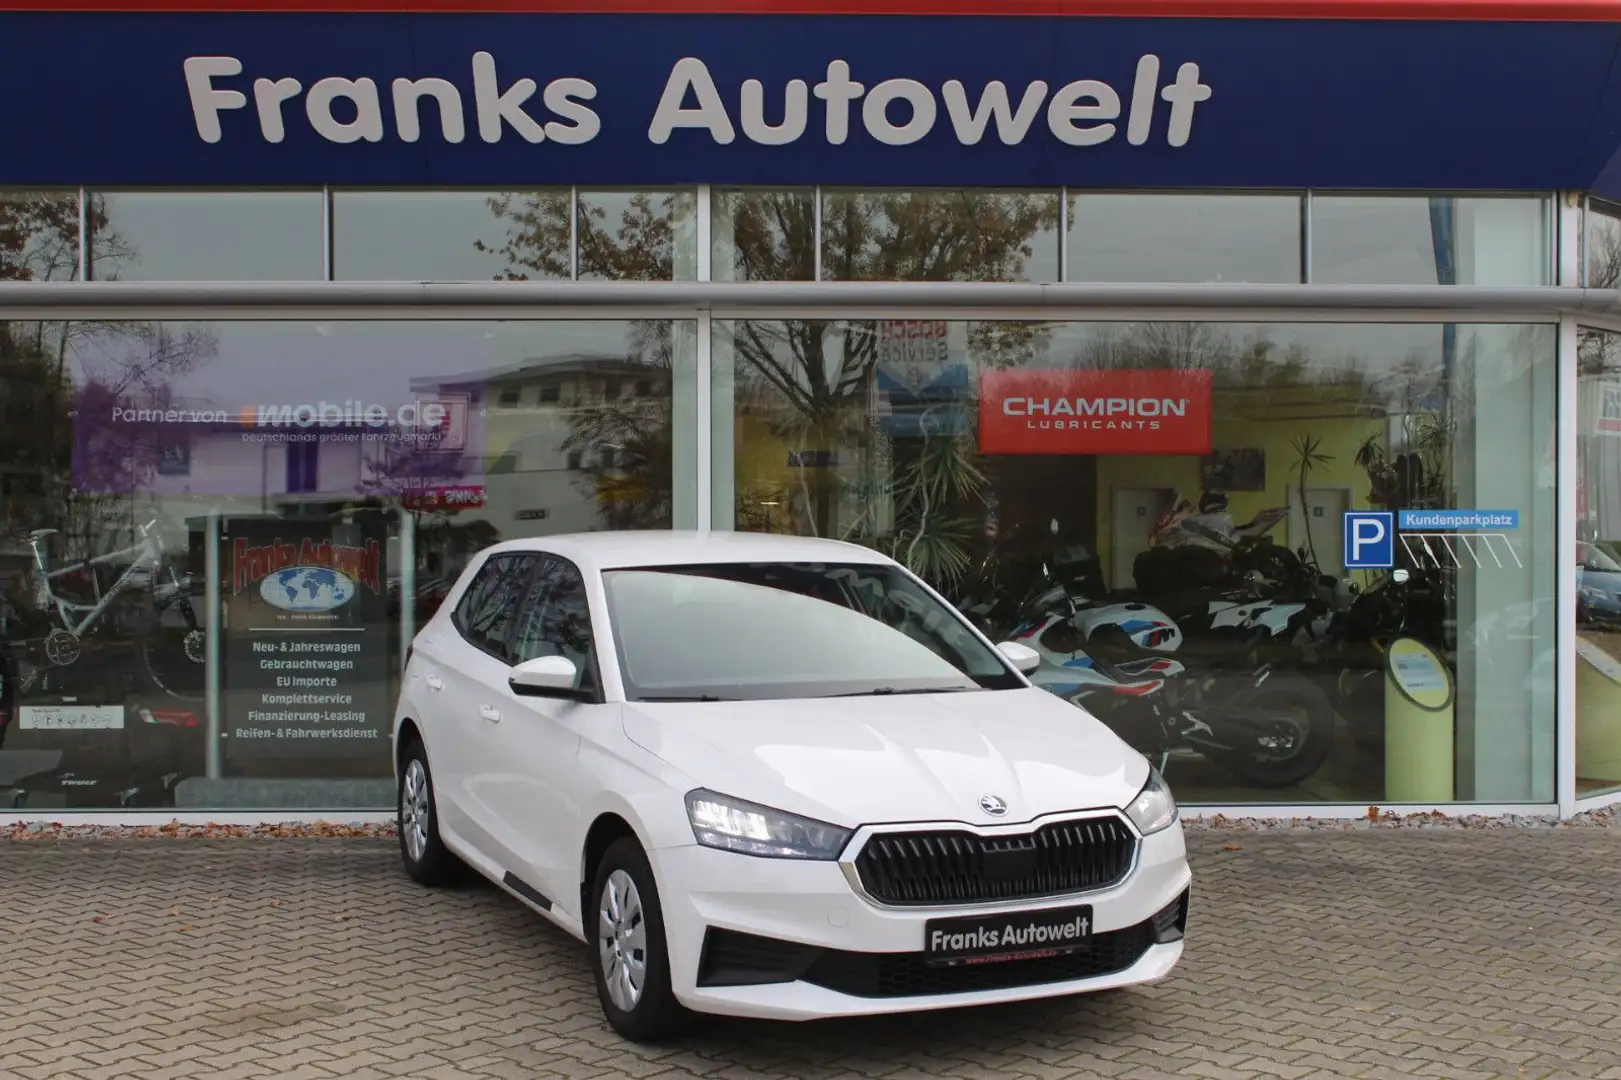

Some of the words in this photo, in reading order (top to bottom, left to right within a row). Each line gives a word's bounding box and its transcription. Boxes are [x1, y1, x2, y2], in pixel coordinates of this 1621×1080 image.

[183, 51, 601, 145] Franks
[647, 53, 1212, 148] Autowelt
[1002, 397, 1185, 416] CHAMPION
[111, 406, 186, 423] Partner
[191, 409, 228, 423] von
[257, 400, 446, 428] mobile.de
[1027, 420, 1161, 429] LUBRICANTS
[242, 432, 317, 443] Deutschlands
[319, 432, 360, 444] größter
[361, 432, 441, 444] Fahrzeugmarkt
[1406, 513, 1513, 528] Kundenparkplatz
[1353, 519, 1384, 561] P
[233, 536, 297, 596] Franks
[298, 536, 380, 595] Autowelt
[253, 641, 278, 652] Neu-
[280, 641, 287, 652] &
[289, 641, 361, 653] Jahreswagen
[260, 659, 353, 670] Gebrauchtwagen
[276, 676, 290, 686] EU
[292, 676, 338, 688] Importe
[262, 693, 352, 705] Komplettservice
[248, 710, 366, 722] Finanzierung-Leasing
[236, 727, 275, 738] Reifen-
[276, 727, 284, 738] &
[285, 727, 378, 738] Fahrwerksdienst
[931, 926, 999, 951] Franks
[1001, 916, 1089, 945] Autowelt
